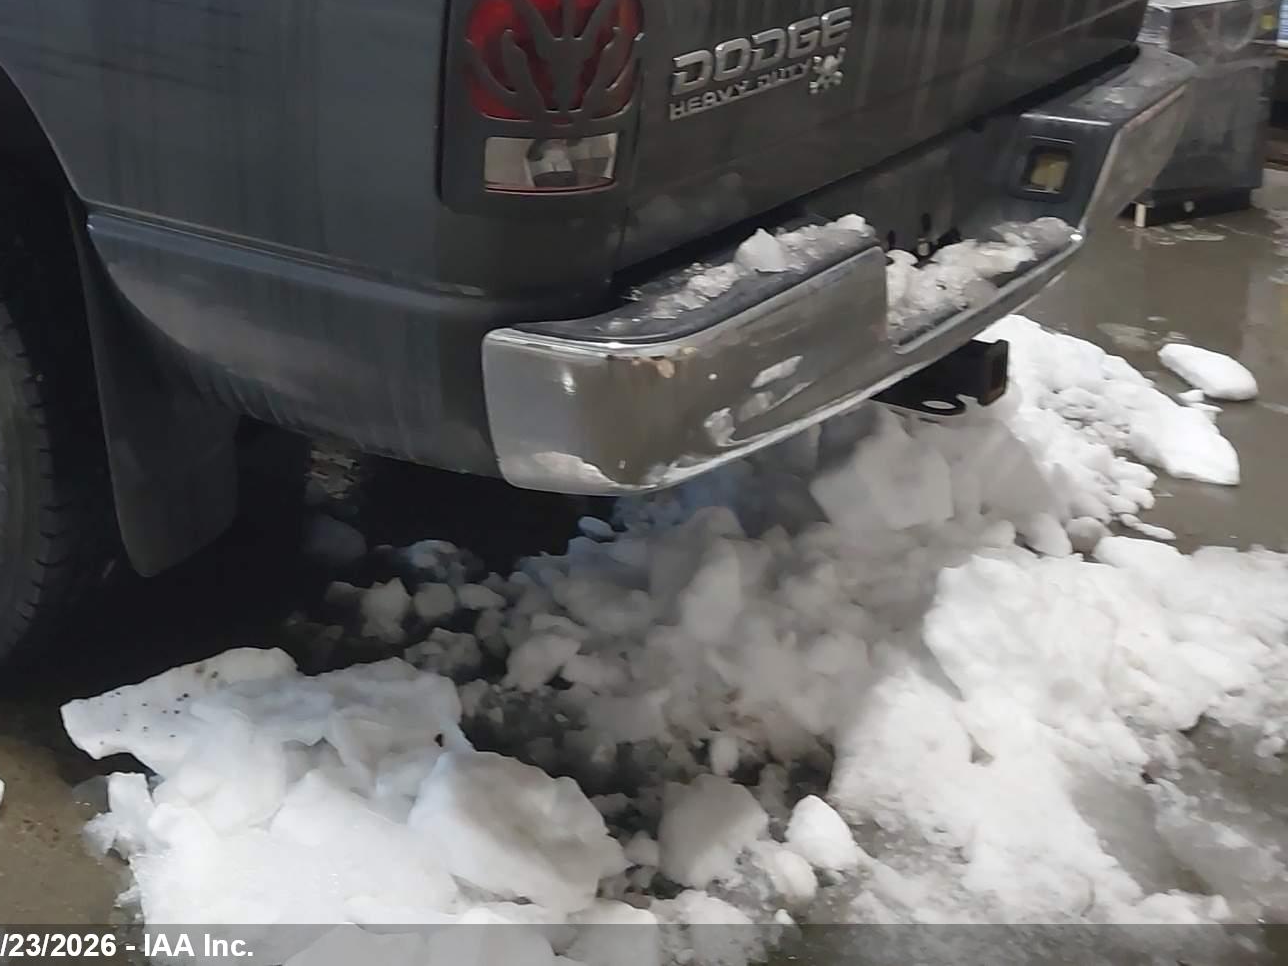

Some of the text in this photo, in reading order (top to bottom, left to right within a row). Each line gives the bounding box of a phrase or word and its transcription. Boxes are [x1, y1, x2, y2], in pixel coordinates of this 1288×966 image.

[671, 6, 853, 96] DODGE
[669, 58, 813, 121] HEAVY DUTY
